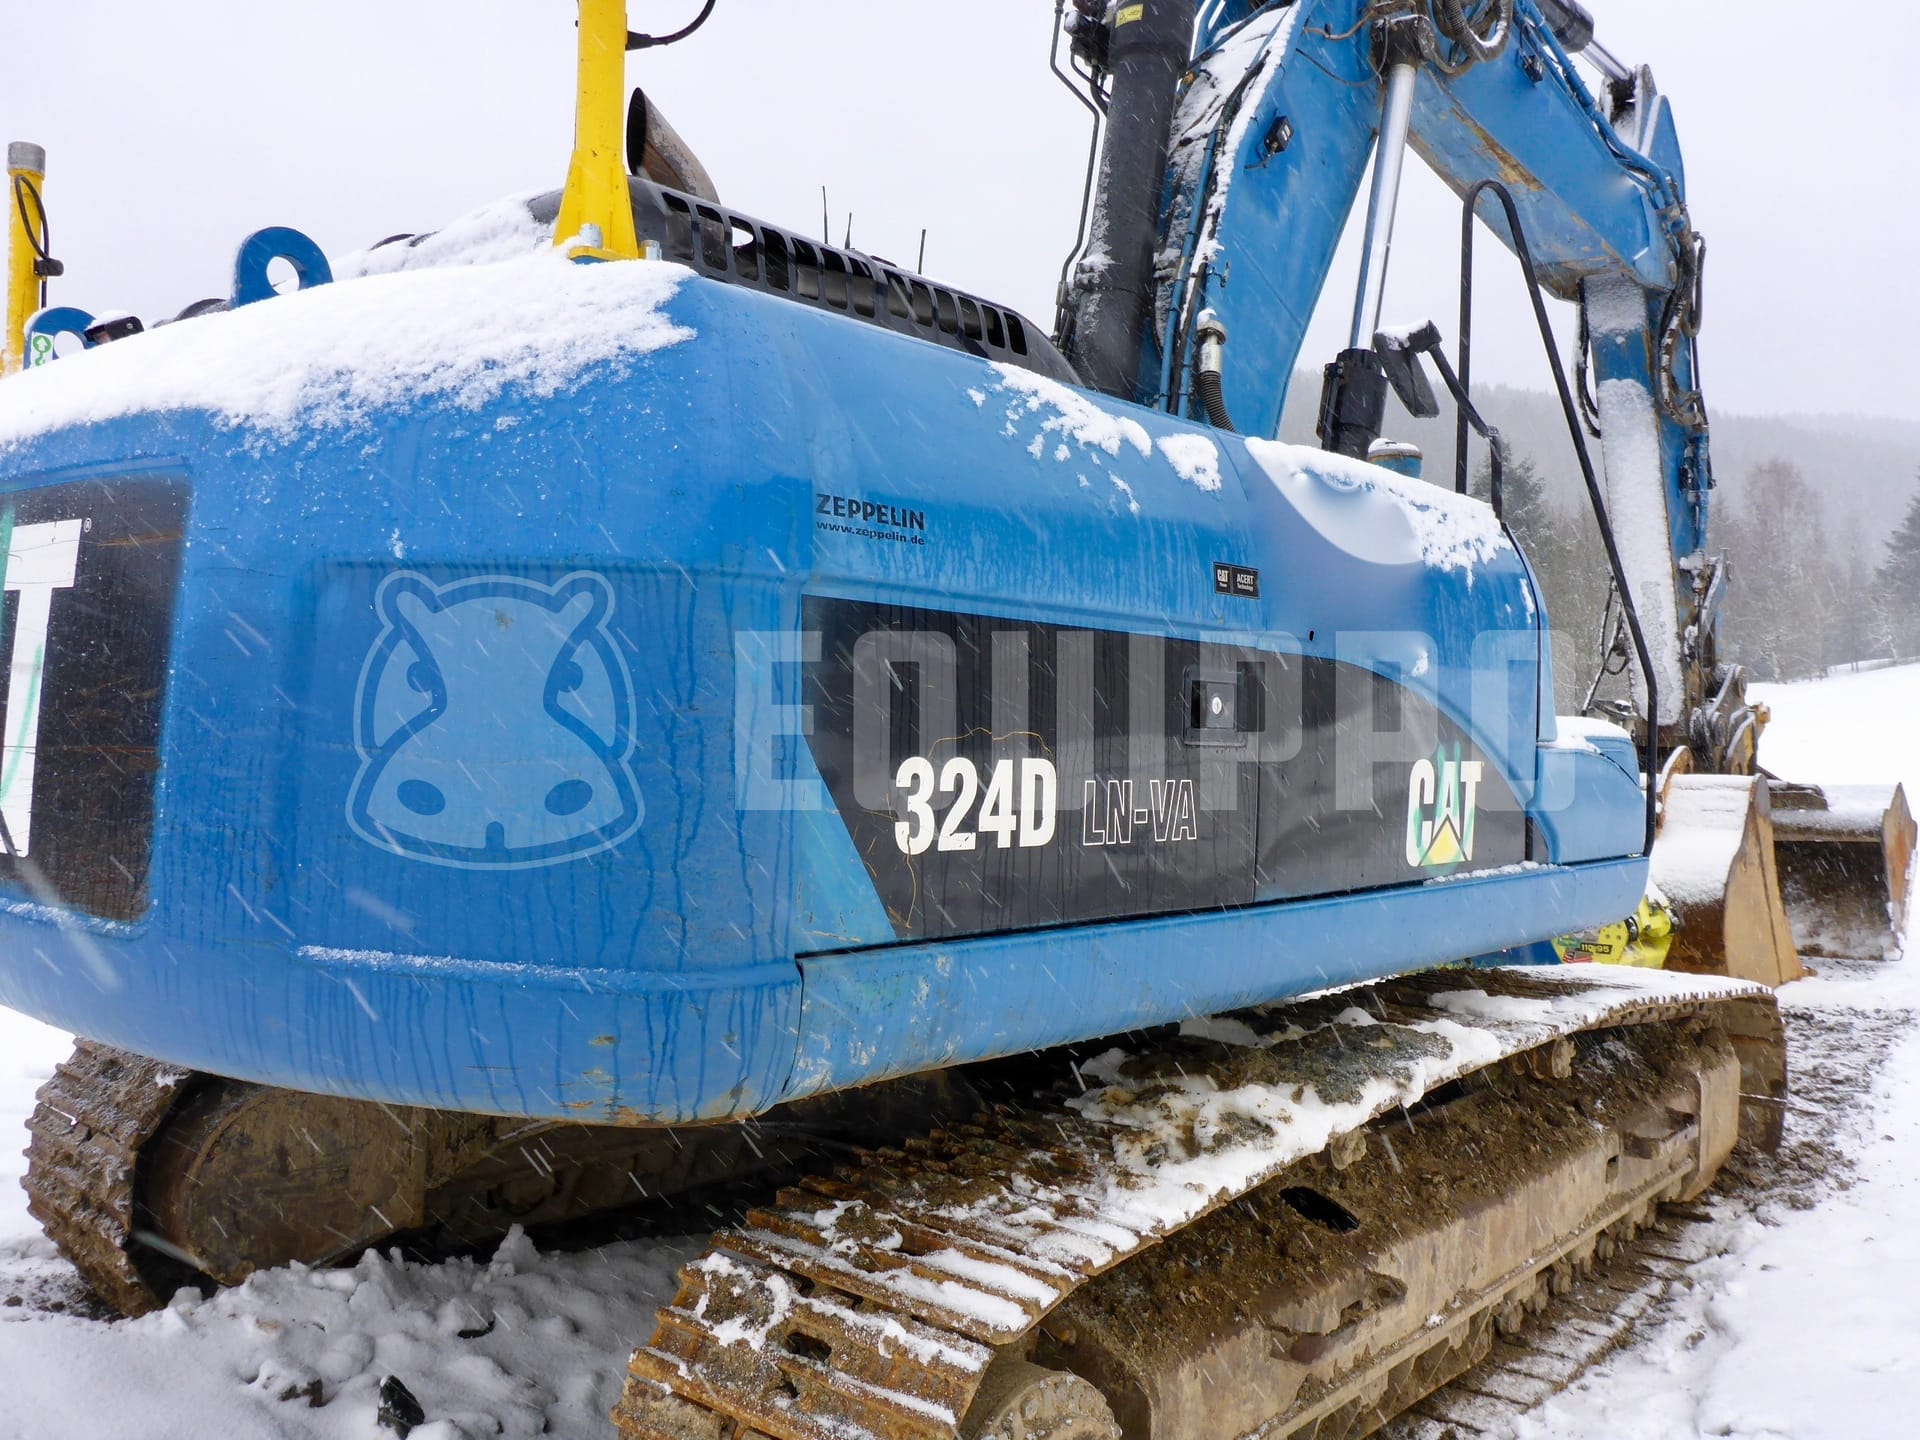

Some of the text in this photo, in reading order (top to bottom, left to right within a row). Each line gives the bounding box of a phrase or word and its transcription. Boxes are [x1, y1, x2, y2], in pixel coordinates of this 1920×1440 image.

[815, 493, 925, 530] ZEPPELIN
[816, 521, 925, 545] www.zeppelin.de
[1217, 568, 1229, 582] CAT
[1236, 573, 1255, 585] ACERT
[894, 756, 1198, 856] 324D LN-VA
[1406, 758, 1482, 868] CAT
